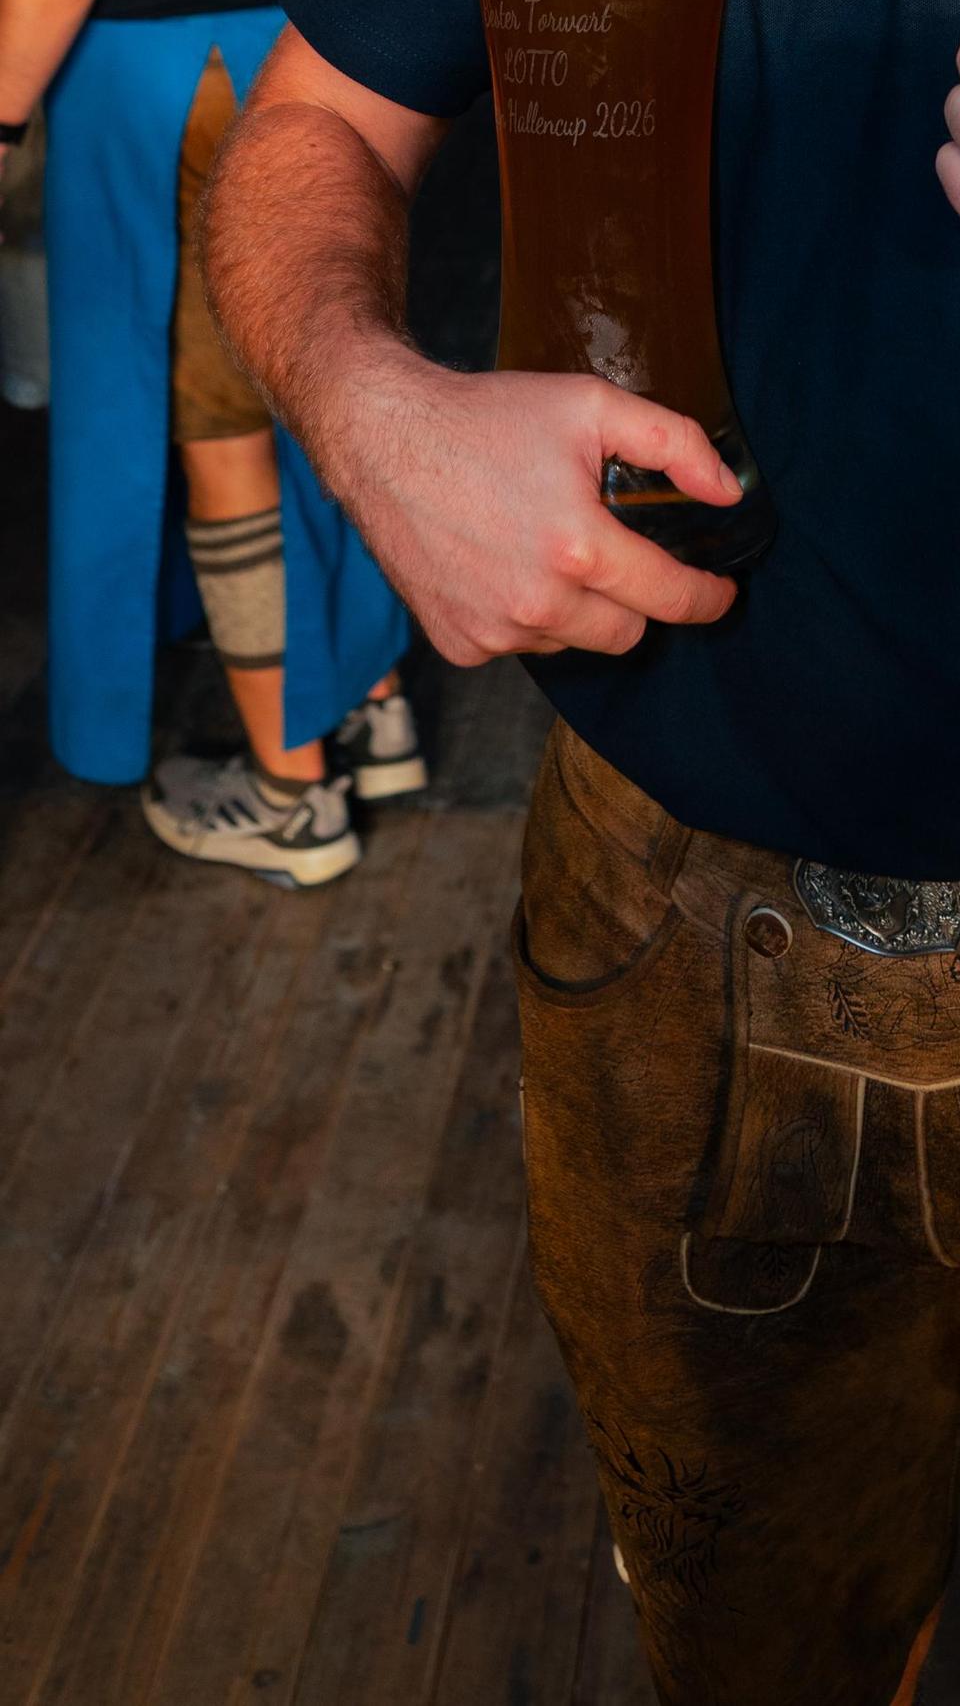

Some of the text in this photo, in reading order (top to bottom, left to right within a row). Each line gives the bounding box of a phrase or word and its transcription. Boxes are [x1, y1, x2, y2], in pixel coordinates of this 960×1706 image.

[504, 48, 568, 86] LOTTO
[507, 98, 656, 146] Hallencup 2026
